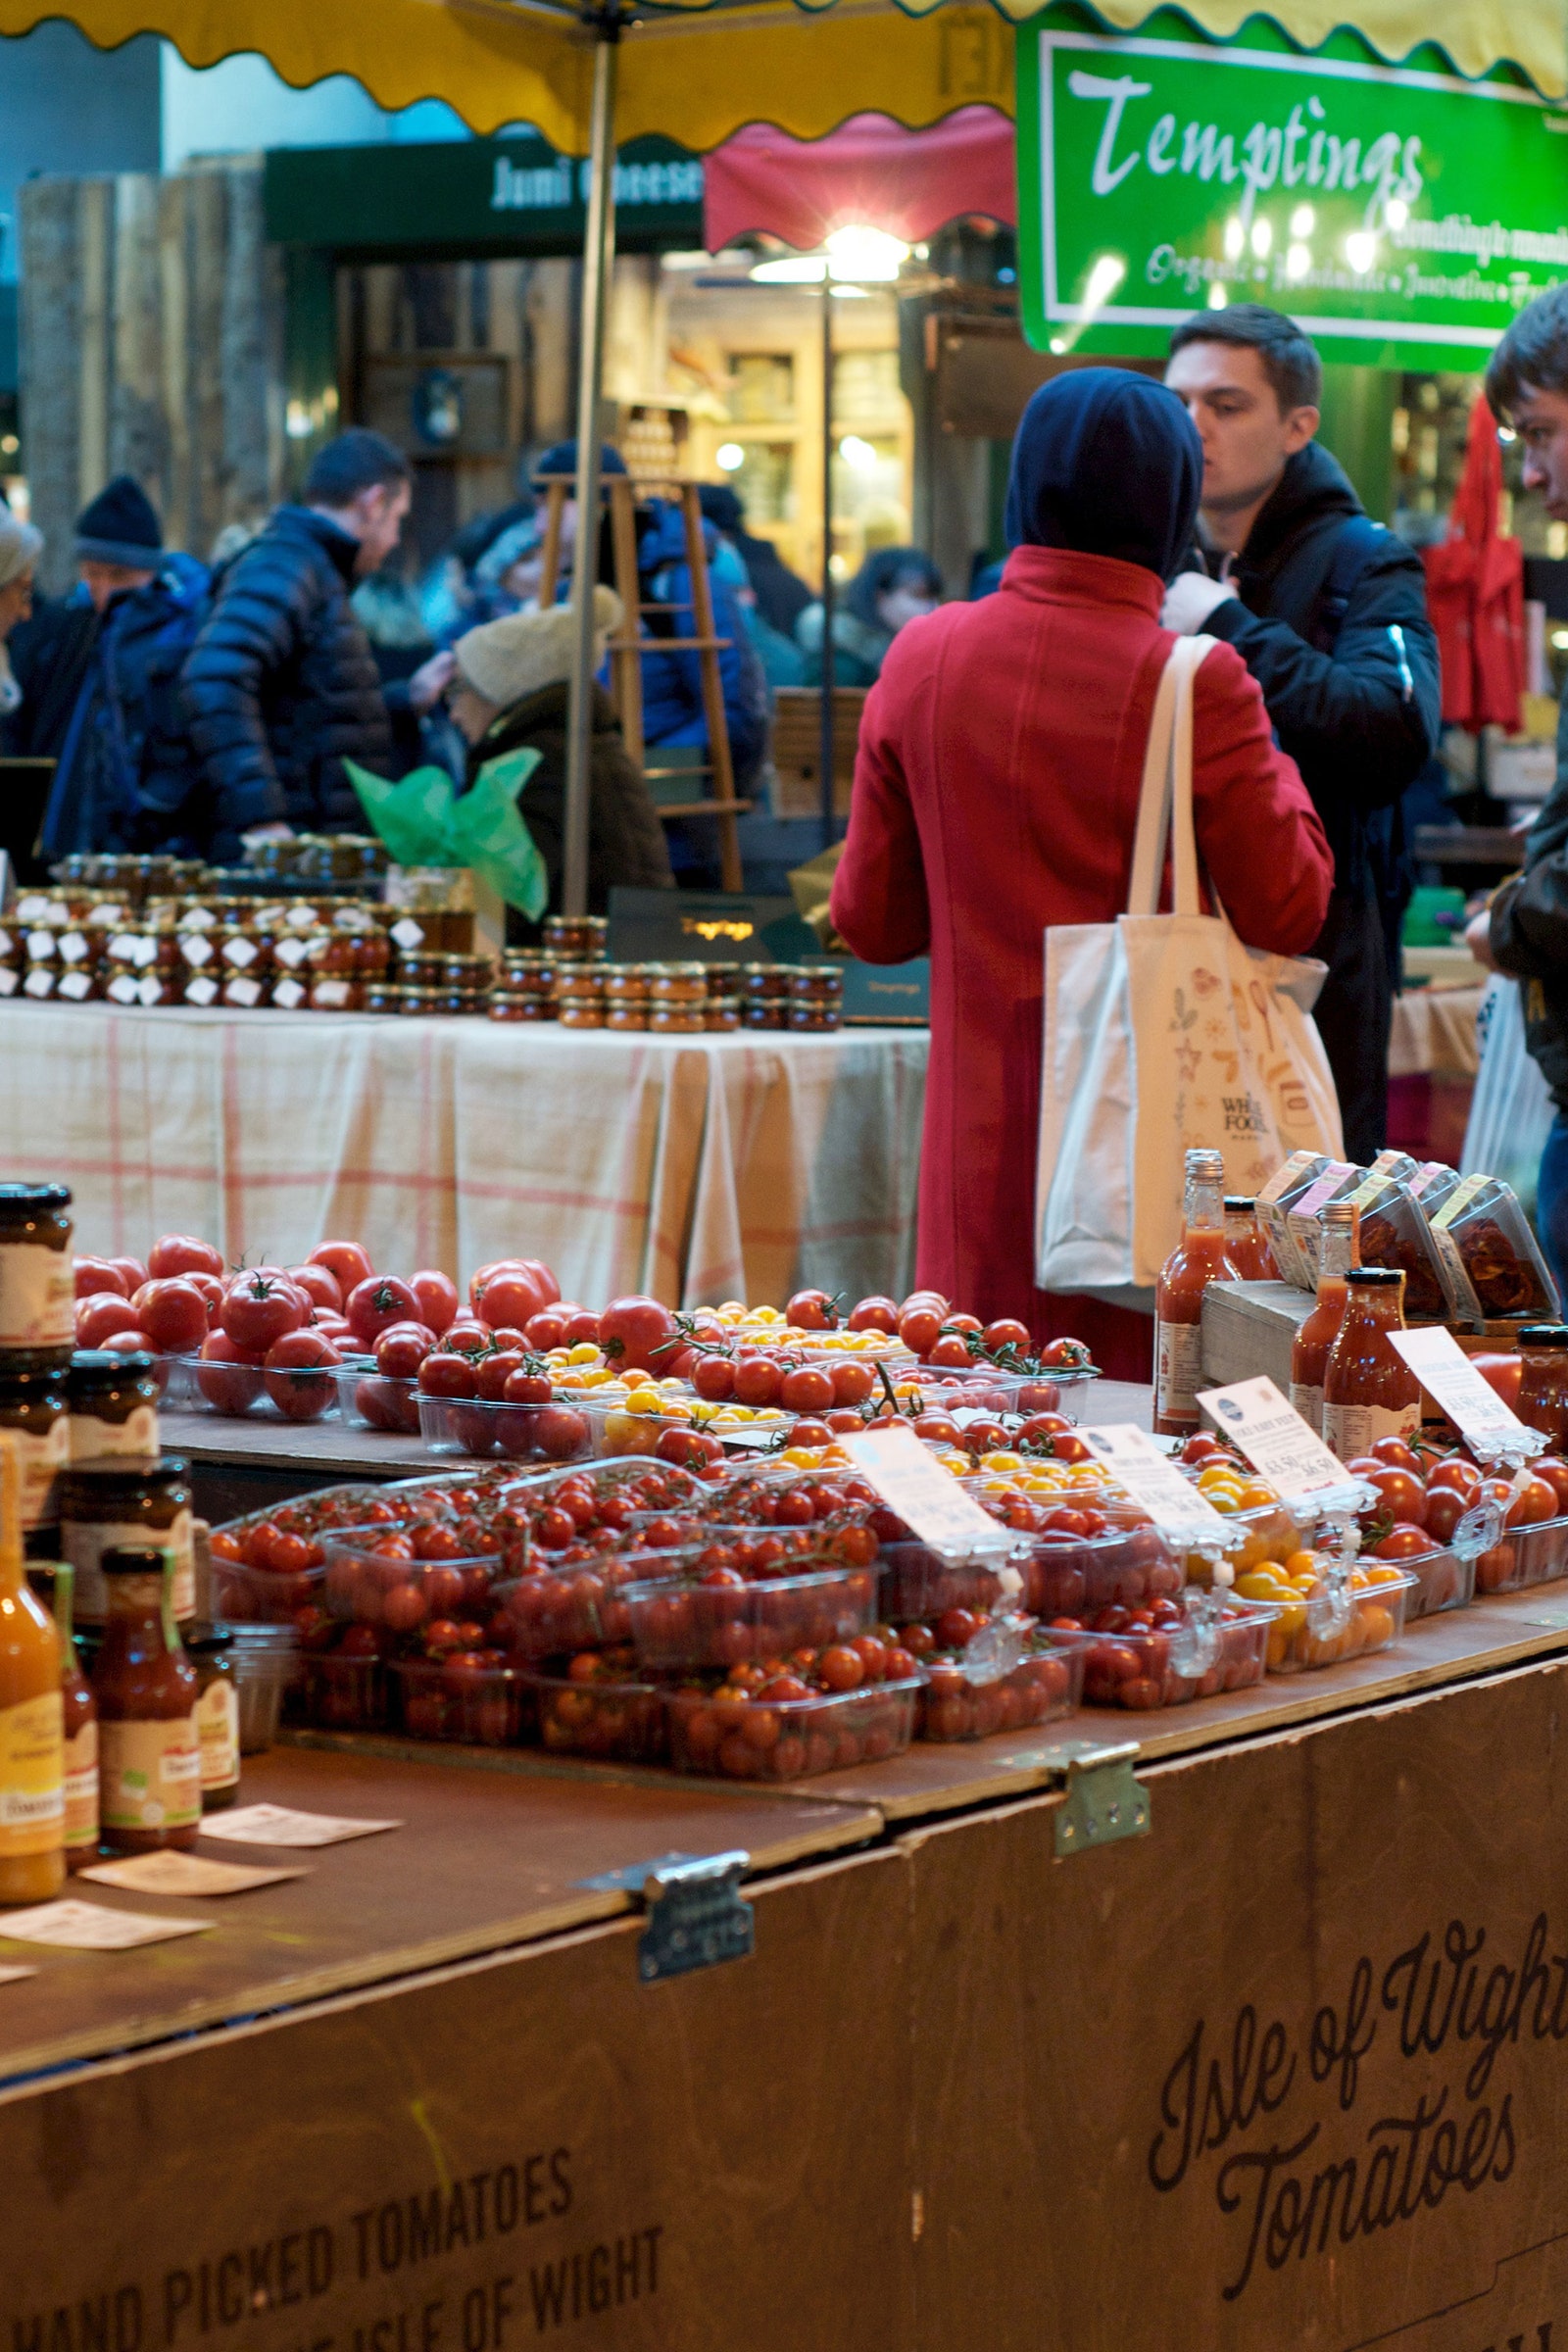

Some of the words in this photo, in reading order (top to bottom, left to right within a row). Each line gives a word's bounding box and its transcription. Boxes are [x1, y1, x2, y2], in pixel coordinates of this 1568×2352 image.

[1068, 69, 1424, 236] Temptings
[1222, 1095, 1262, 1115] WHLE
[1148, 2004, 1298, 2193] Isle
[1309, 1956, 1378, 2111] of
[163, 2225, 335, 2347] PICKED
[350, 2146, 573, 2281] TOMATOES
[1216, 2084, 1516, 2302] Tomatoes
[462, 2276, 514, 2352] OF
[530, 2225, 663, 2335] WIGHT
